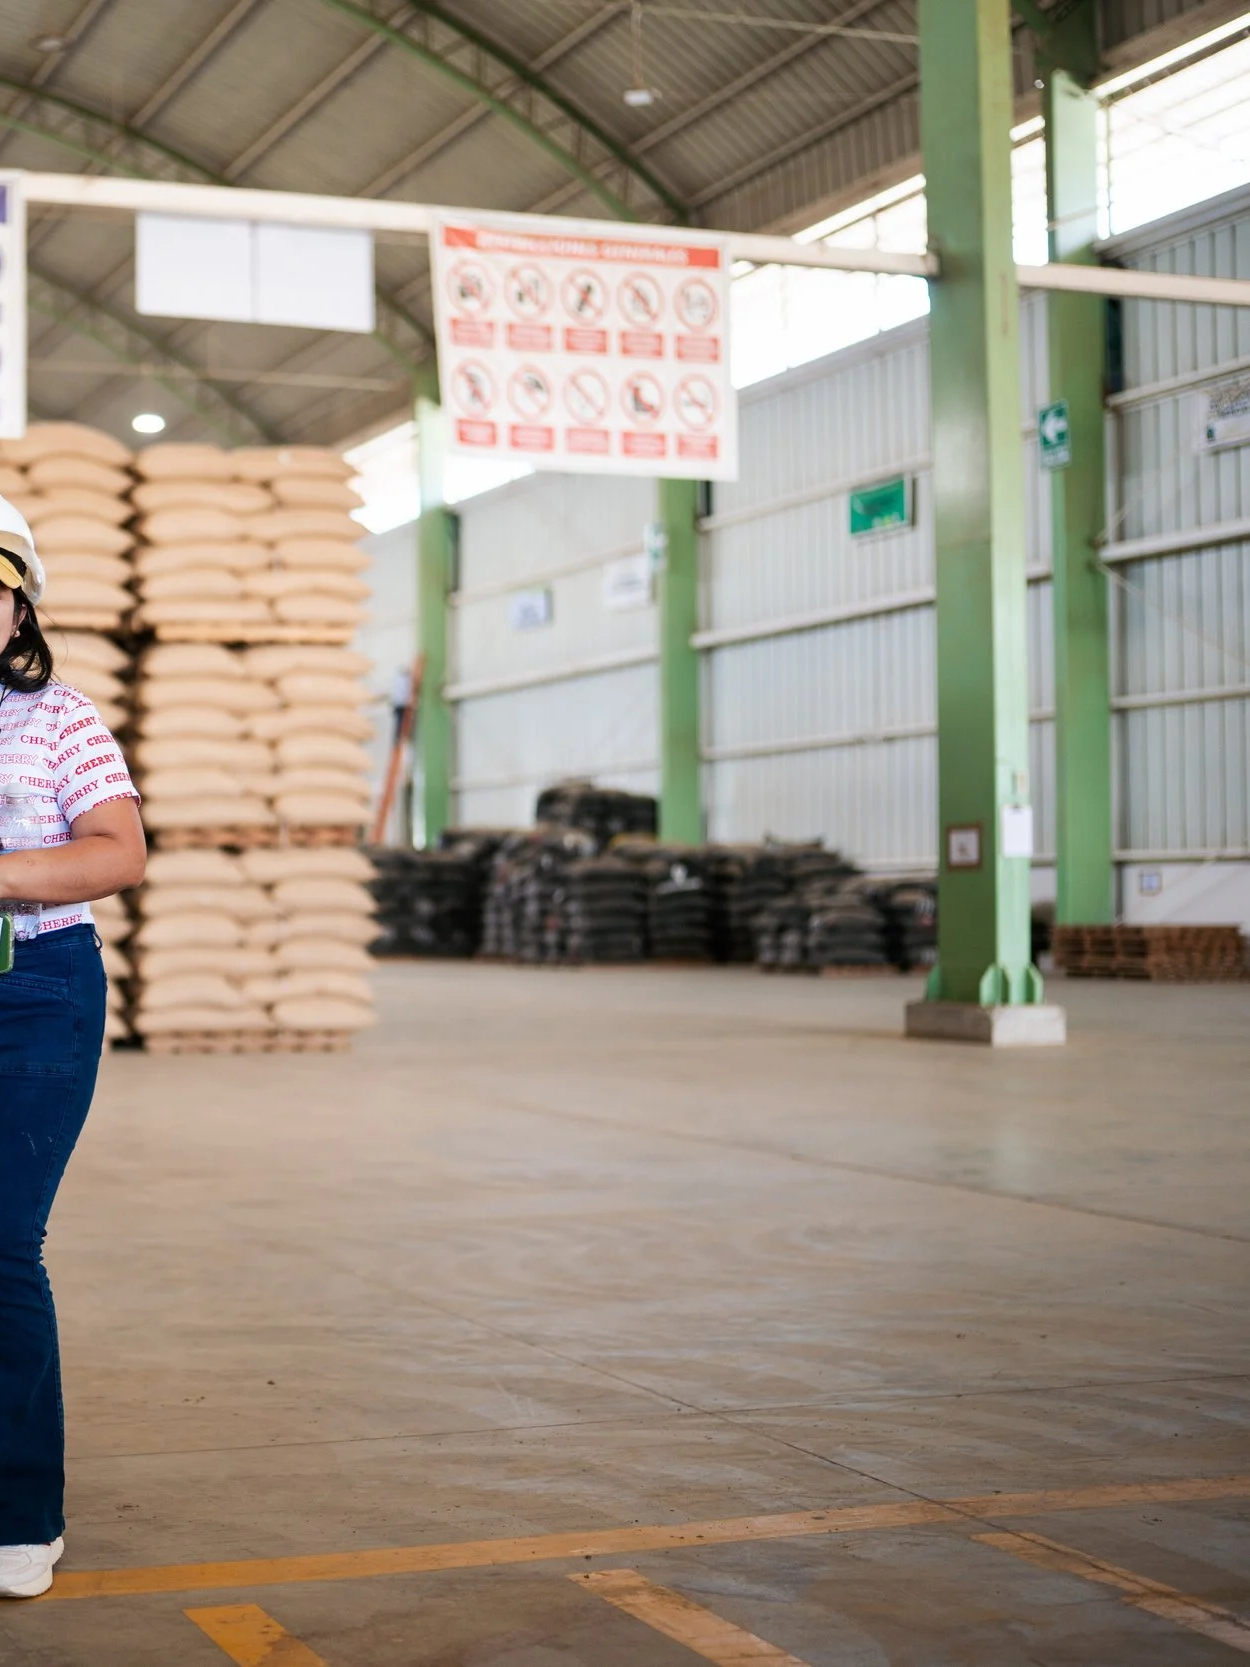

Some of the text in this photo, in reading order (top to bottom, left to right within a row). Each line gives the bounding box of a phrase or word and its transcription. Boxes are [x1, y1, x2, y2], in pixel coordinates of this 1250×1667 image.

[59, 716, 97, 740] CHERRY
[75, 754, 116, 775] CHERRY
[62, 779, 99, 812] HERRY
